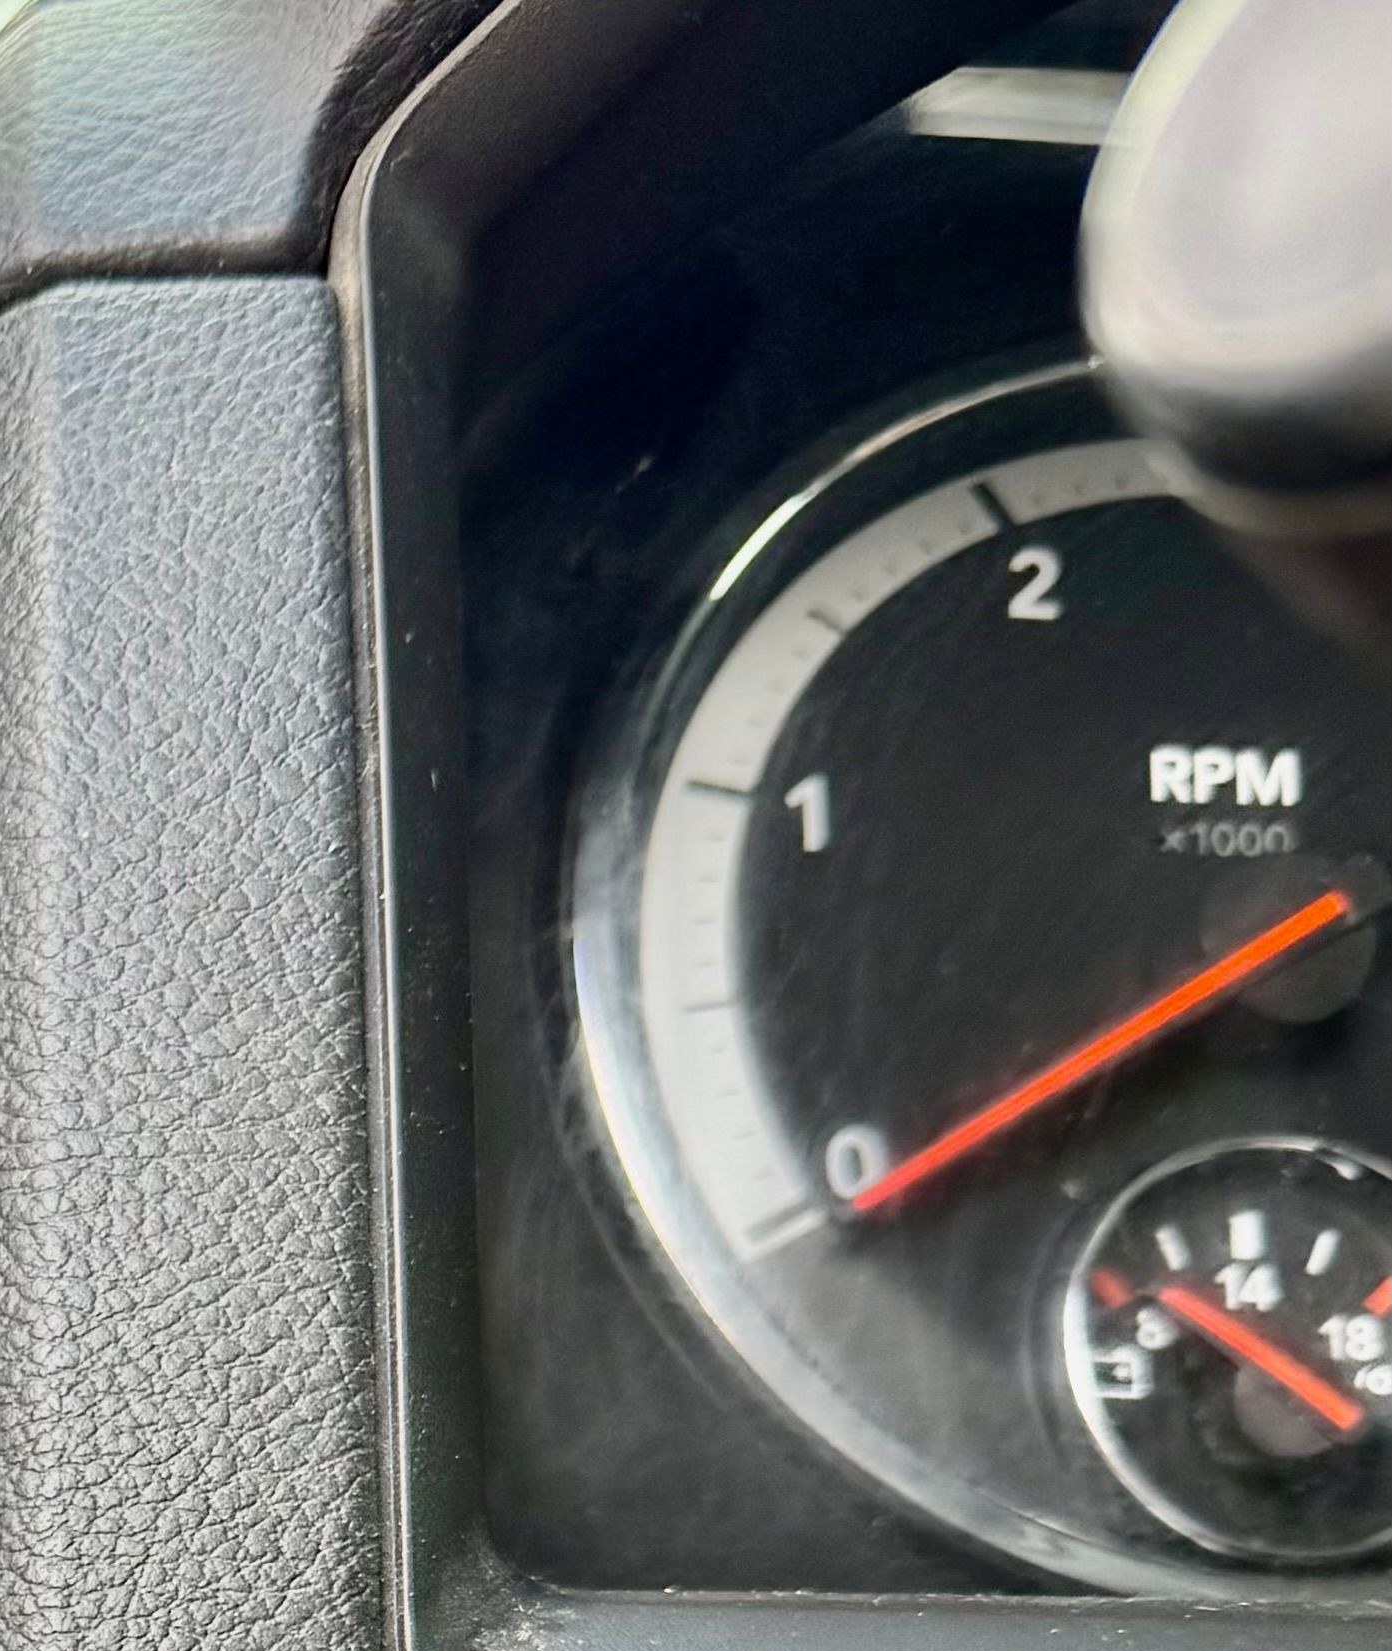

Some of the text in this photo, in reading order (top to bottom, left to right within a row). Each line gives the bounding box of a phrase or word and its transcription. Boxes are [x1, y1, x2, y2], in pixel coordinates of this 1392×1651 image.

[1008, 547, 1061, 620] 2
[1149, 744, 1301, 807] RPM
[784, 774, 831, 852] 1
[825, 1123, 888, 1201] 0
[1214, 1264, 1283, 1312] 14
[1317, 1313, 1385, 1361] 18
